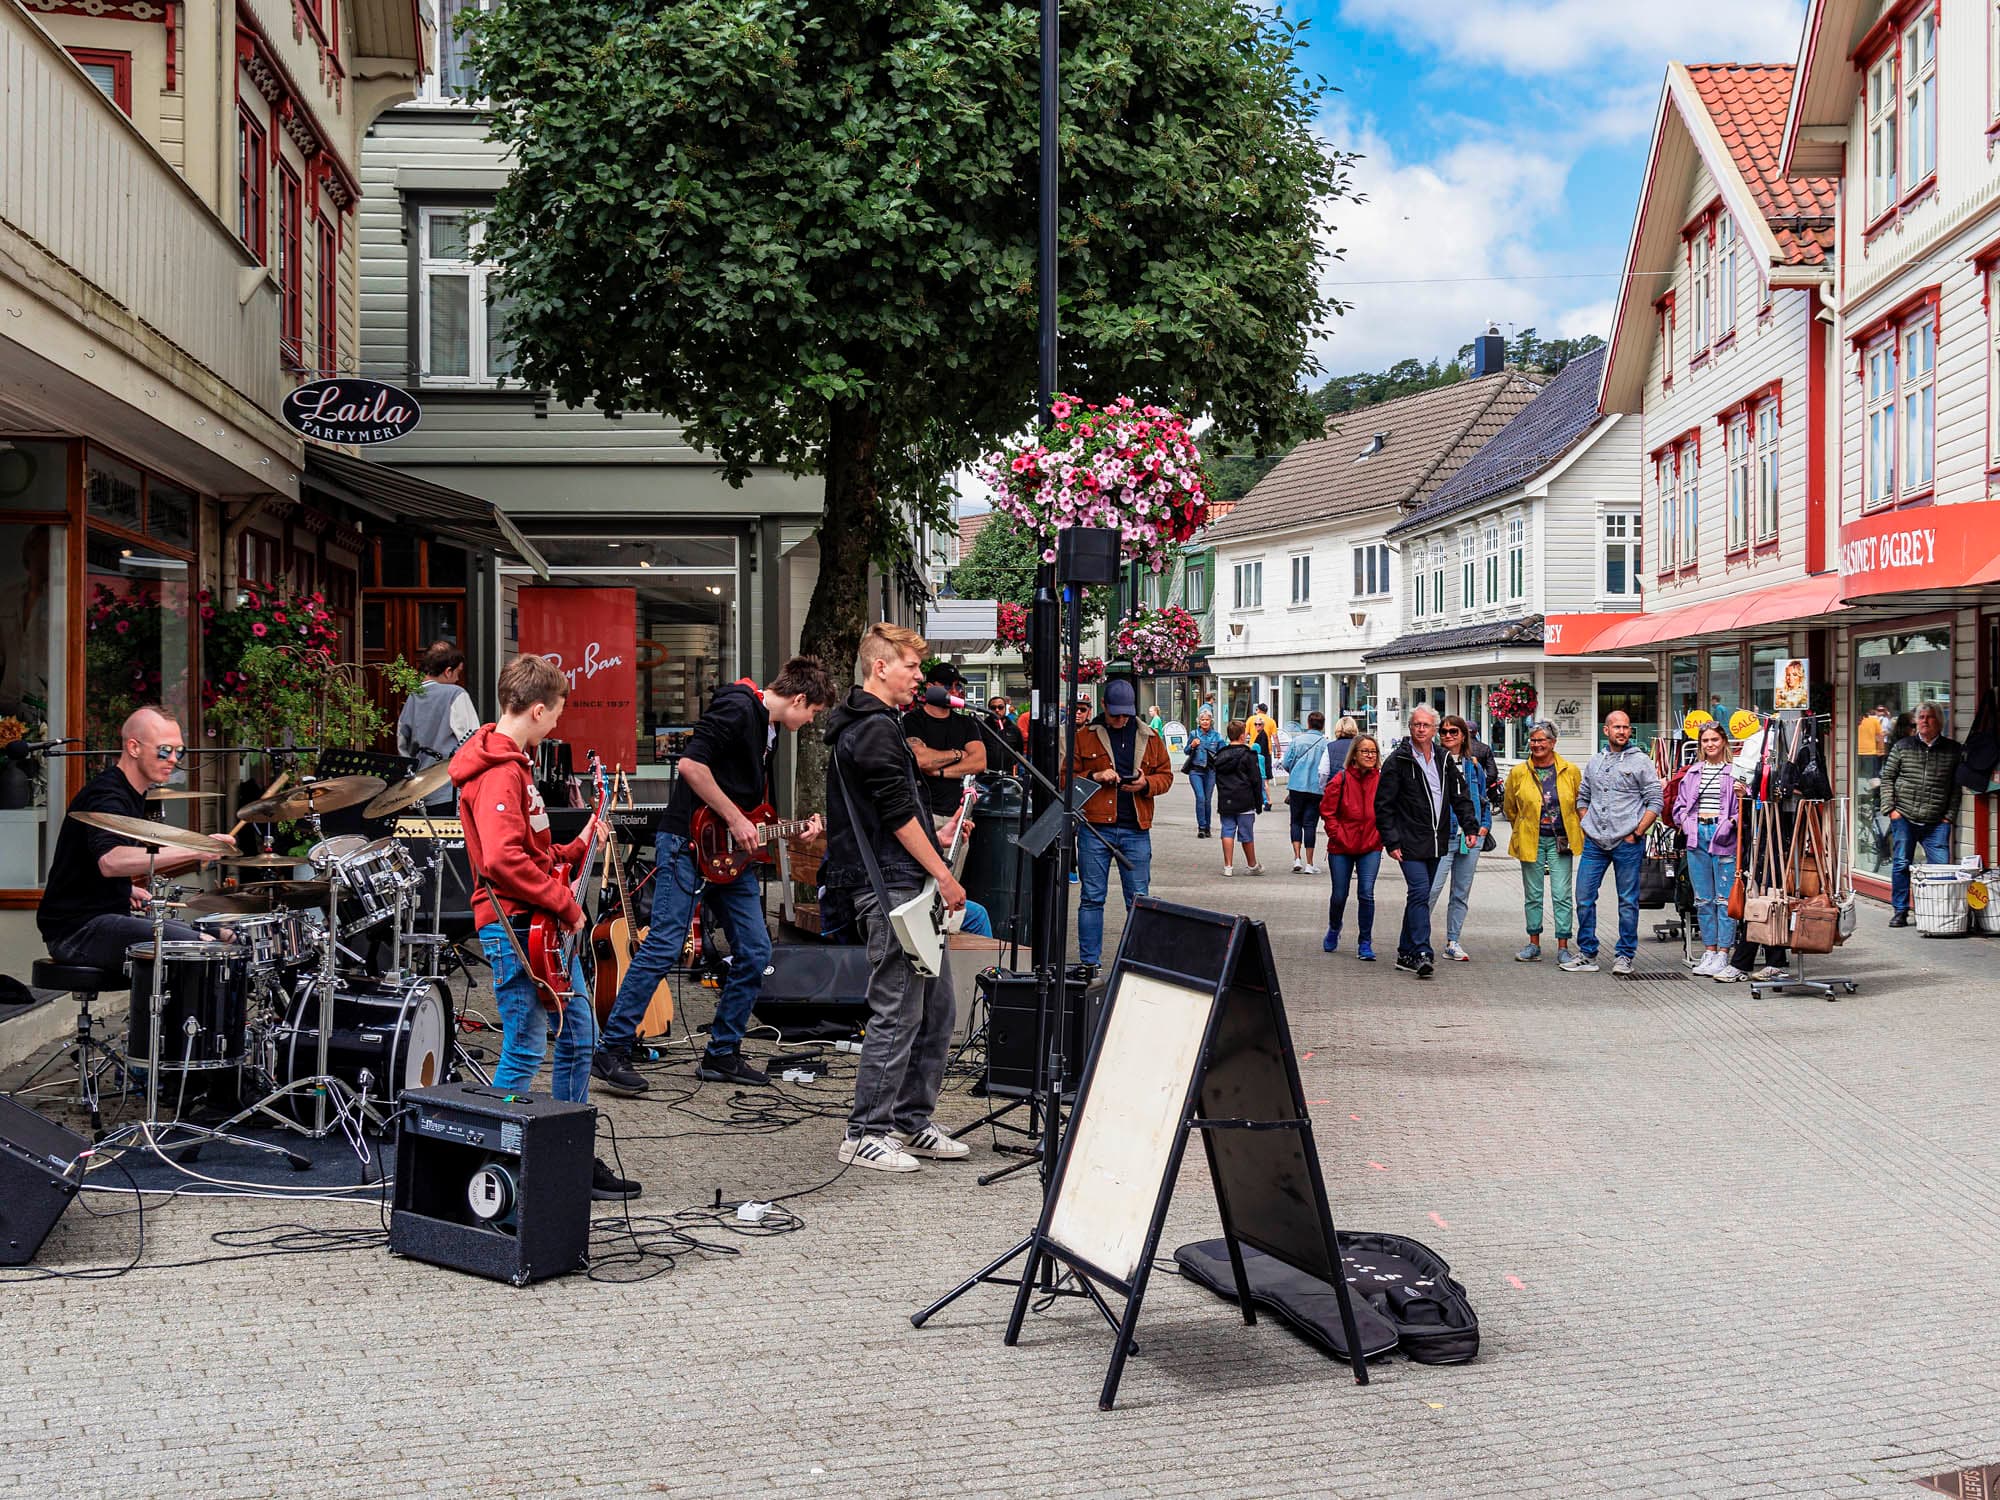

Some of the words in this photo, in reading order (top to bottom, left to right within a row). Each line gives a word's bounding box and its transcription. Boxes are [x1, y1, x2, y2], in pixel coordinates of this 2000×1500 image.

[292, 386, 412, 424] Laila
[301, 421, 402, 441] PARFYMERI
[1880, 529, 1936, 570] ØGREY
[1731, 713, 1758, 735] SALG
[620, 815, 648, 825] Roland
